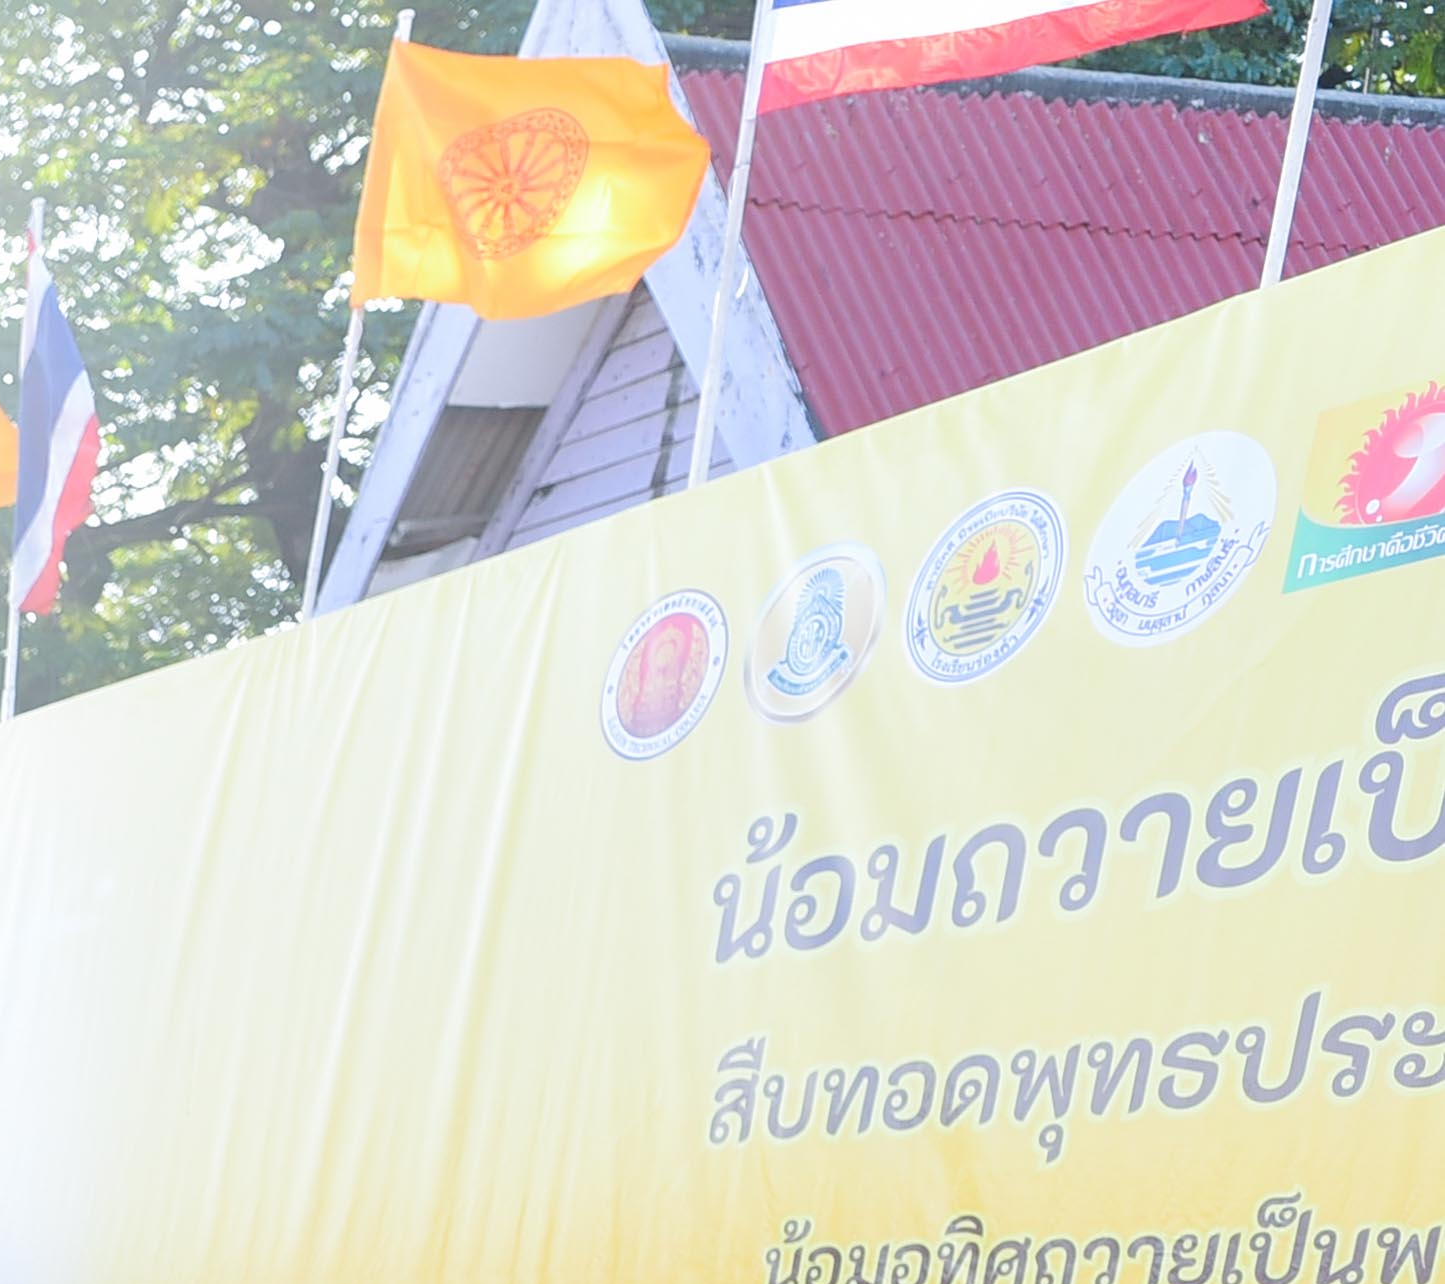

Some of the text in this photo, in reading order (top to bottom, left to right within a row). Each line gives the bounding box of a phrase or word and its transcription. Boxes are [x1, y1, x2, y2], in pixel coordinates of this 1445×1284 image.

[708, 991, 1445, 1160] สืบทอดพุทธประ
